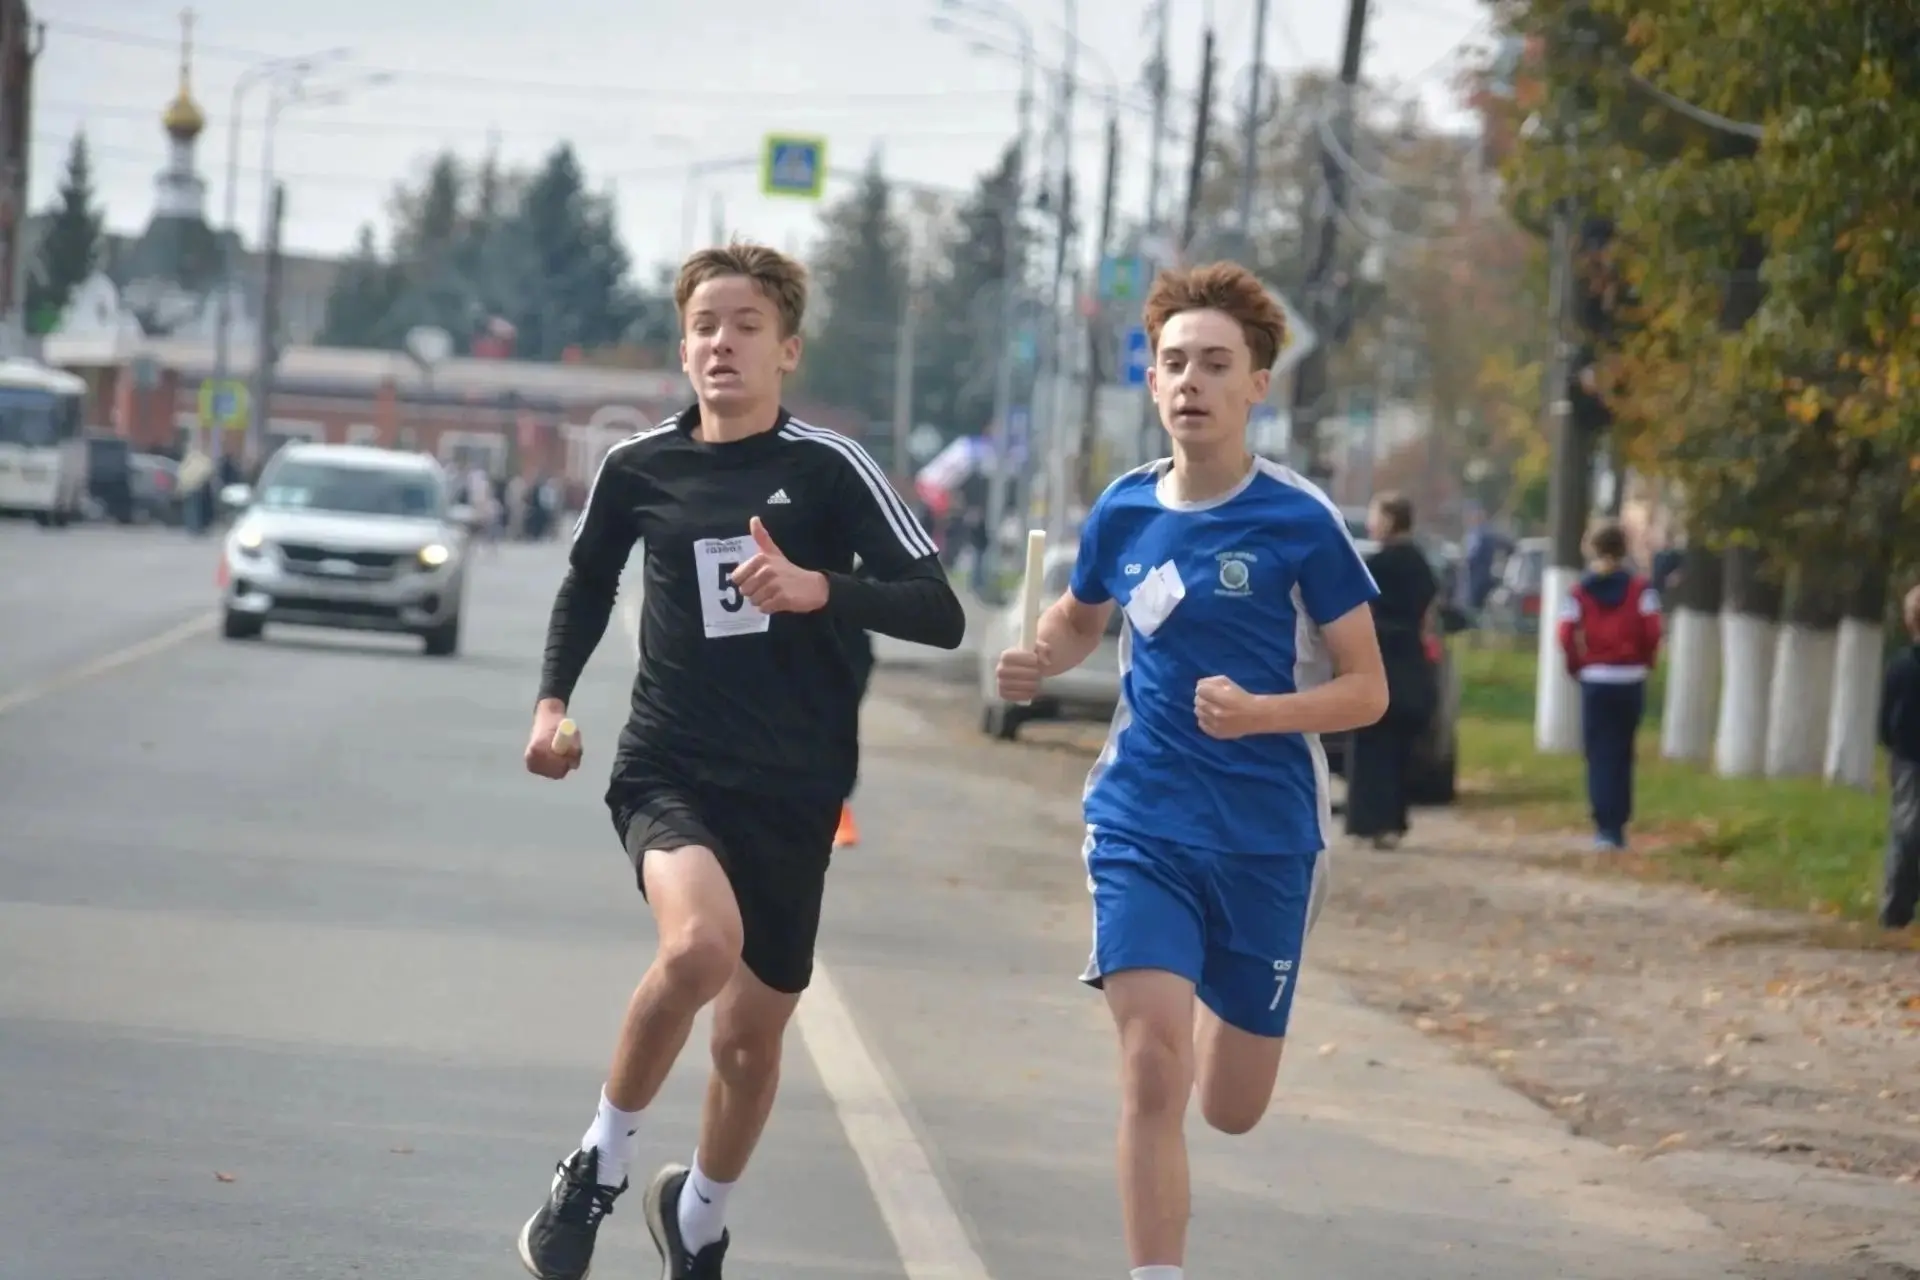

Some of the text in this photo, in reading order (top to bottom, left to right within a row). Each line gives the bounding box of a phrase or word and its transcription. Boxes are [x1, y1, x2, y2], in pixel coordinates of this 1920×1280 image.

[718, 562, 744, 612] 5
[1273, 960, 1292, 971] GS
[1269, 975, 1287, 1010] 7
